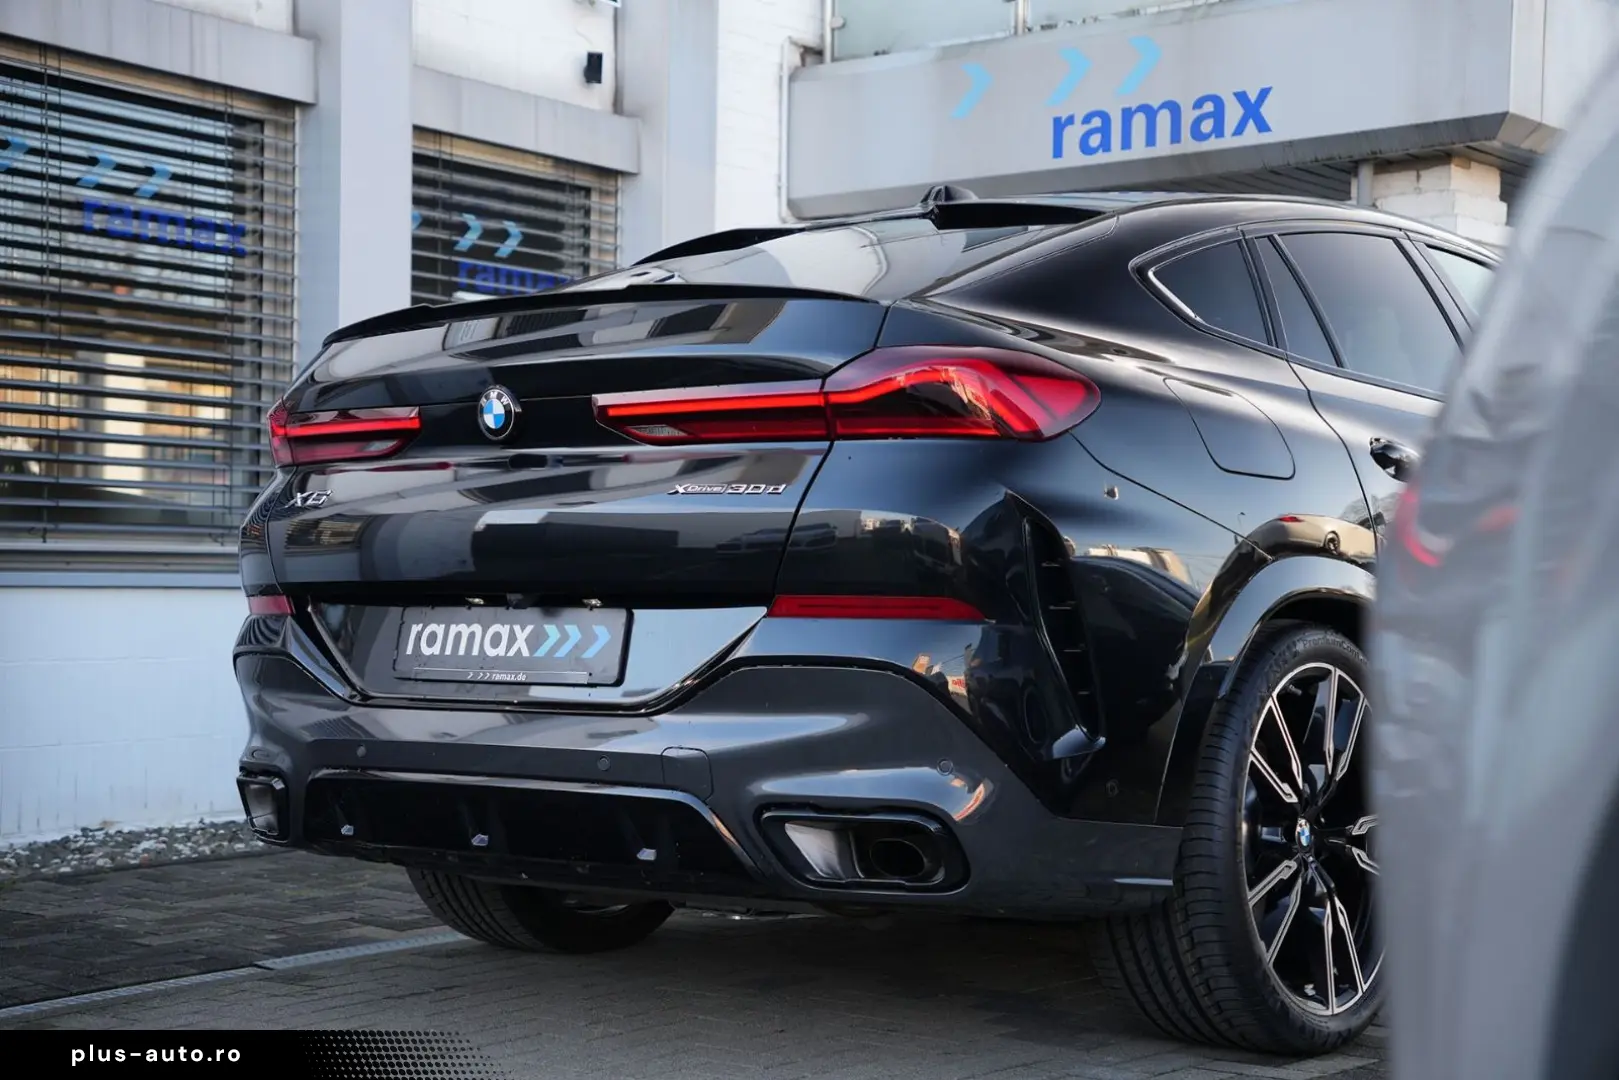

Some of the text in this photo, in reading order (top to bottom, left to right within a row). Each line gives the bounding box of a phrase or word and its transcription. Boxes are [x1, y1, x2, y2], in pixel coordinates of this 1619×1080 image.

[1052, 86, 1273, 160] ramax
[84, 198, 247, 258] ramax
[480, 391, 510, 407] BMW
[285, 489, 333, 508] X6
[405, 622, 534, 657] ramax
[491, 672, 527, 682] ramax.de
